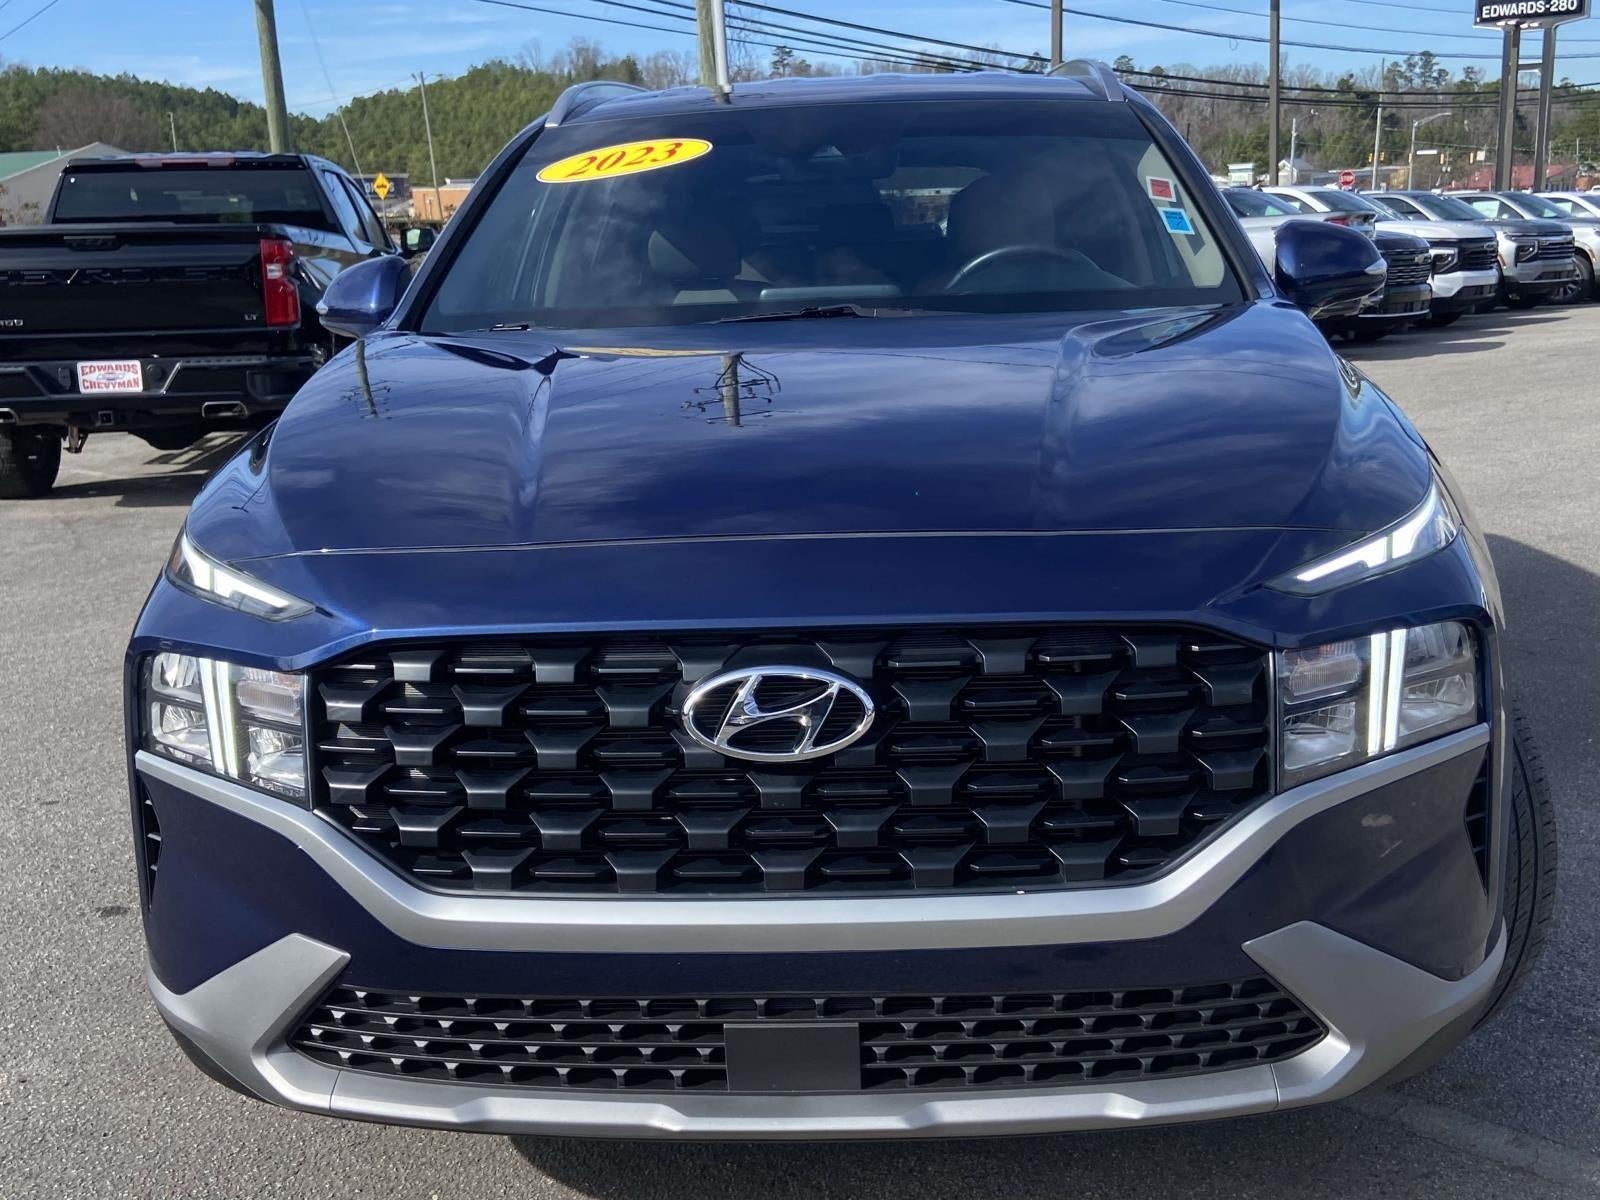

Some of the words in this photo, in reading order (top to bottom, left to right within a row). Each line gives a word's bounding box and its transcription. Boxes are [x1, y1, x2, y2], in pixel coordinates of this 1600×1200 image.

[1482, 0, 1577, 18] EDWARDS-280
[565, 142, 683, 178] 2023
[80, 363, 139, 377] EDWARDS
[82, 377, 140, 390] CHEVYMAN
